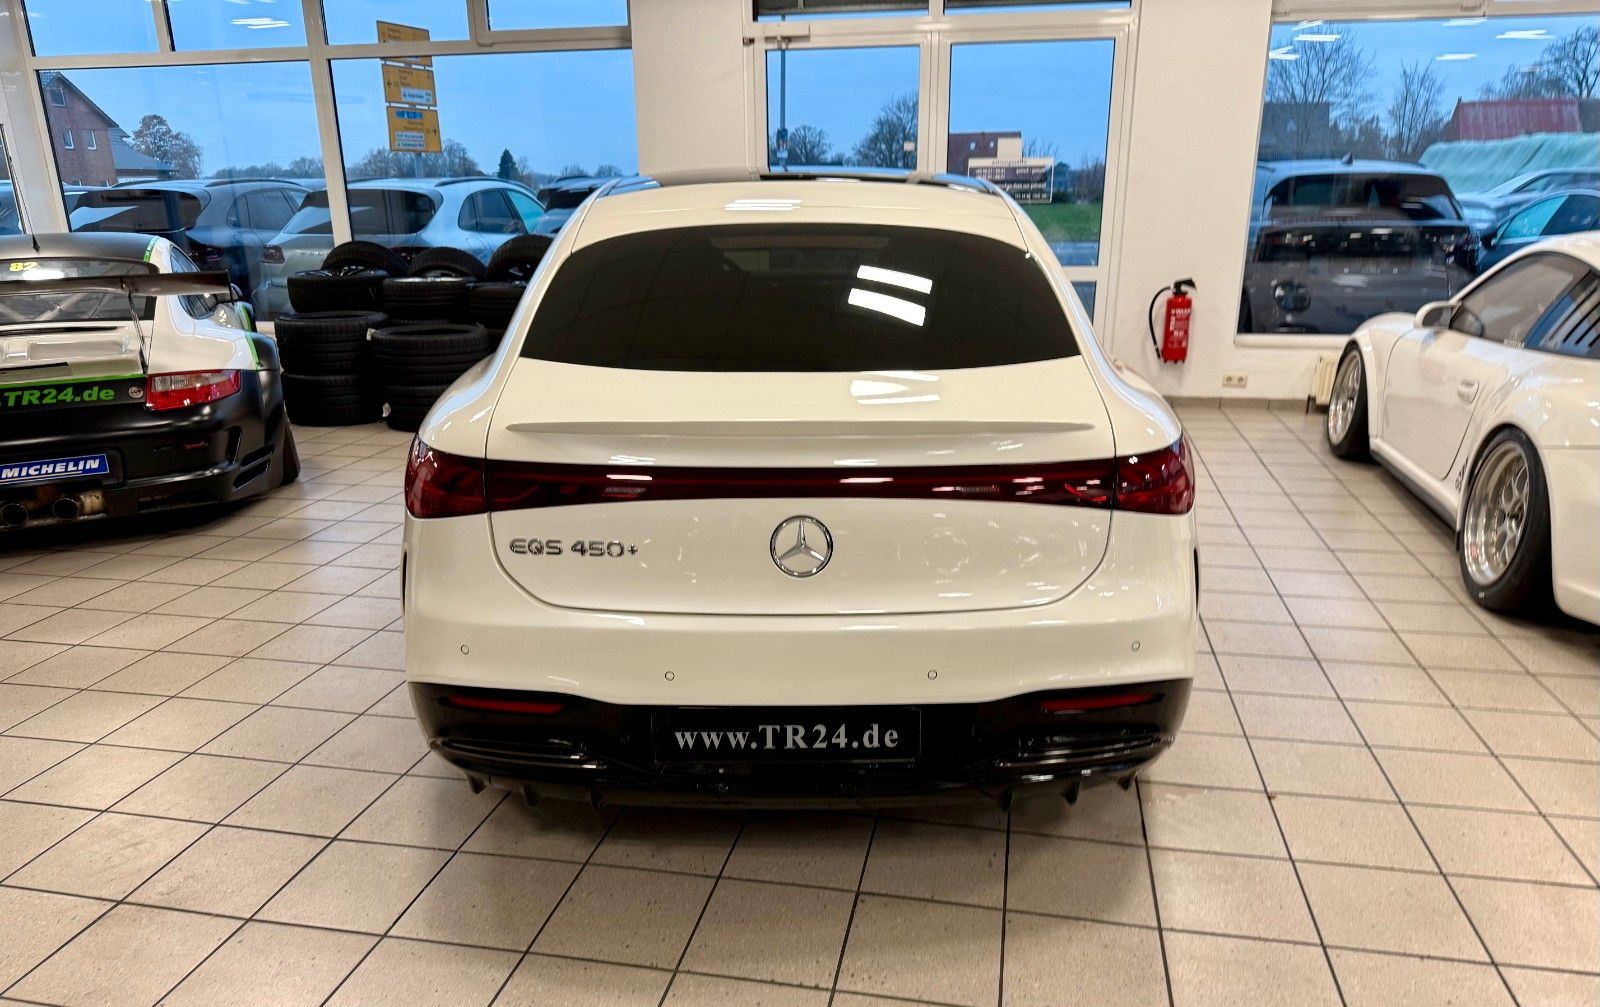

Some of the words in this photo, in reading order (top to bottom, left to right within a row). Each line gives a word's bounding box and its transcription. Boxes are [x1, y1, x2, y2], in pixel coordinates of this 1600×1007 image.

[0, 386, 115, 407] TR24.de
[1, 459, 100, 479] MICHELIN
[509, 538, 562, 556] EQS
[571, 539, 638, 557] 450+
[674, 723, 899, 750] www.TR24.de
